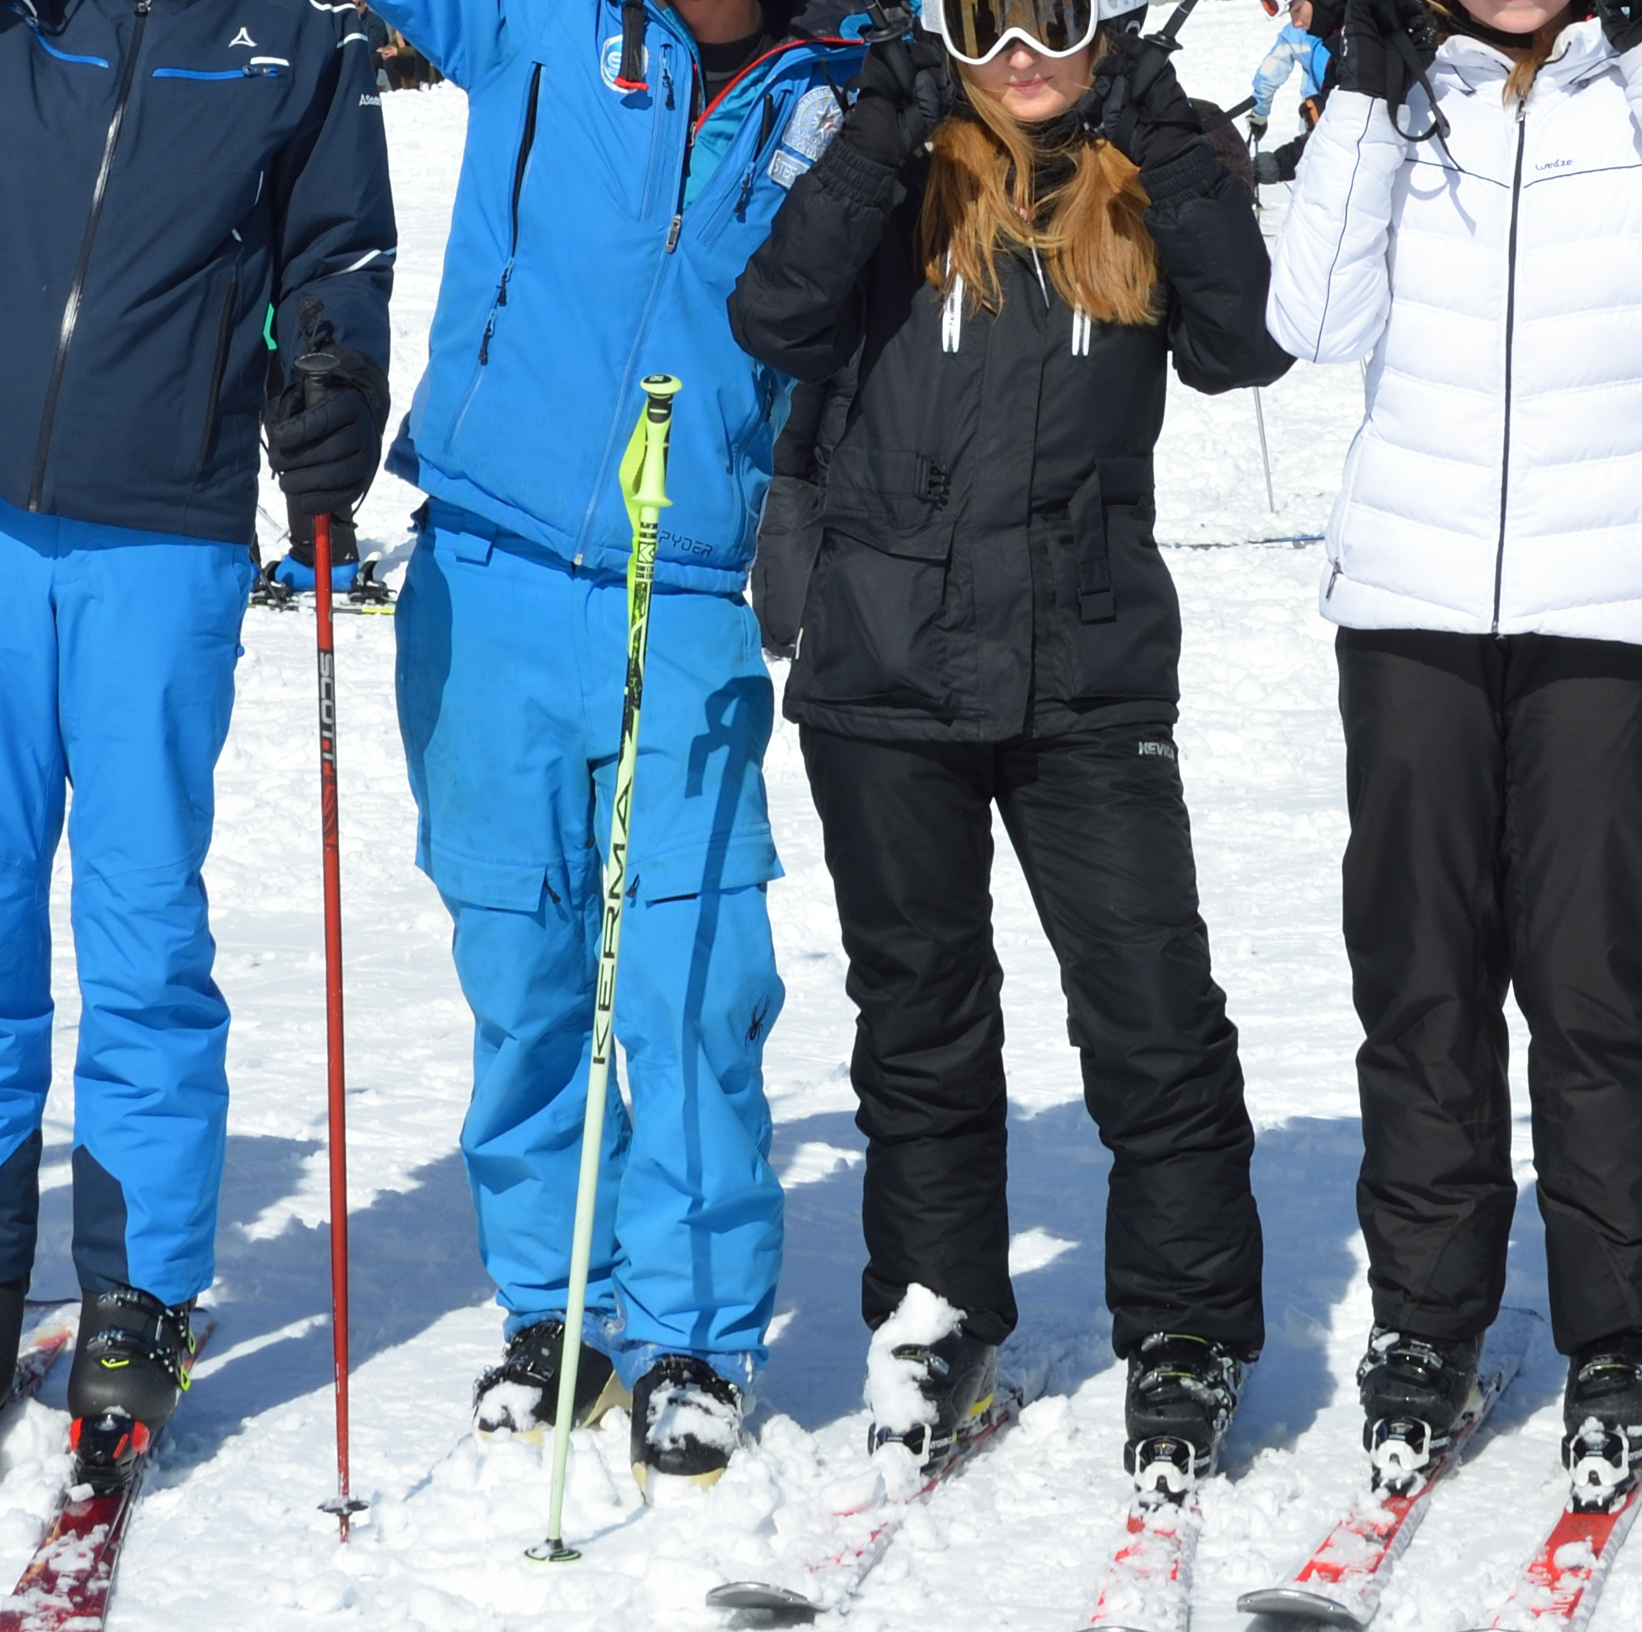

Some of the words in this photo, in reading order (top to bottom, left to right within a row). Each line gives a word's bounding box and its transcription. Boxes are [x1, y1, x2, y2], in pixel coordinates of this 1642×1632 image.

[658, 530, 713, 557] PYDER
[319, 651, 337, 770] SCOTT
[593, 774, 633, 1064] KERMA
